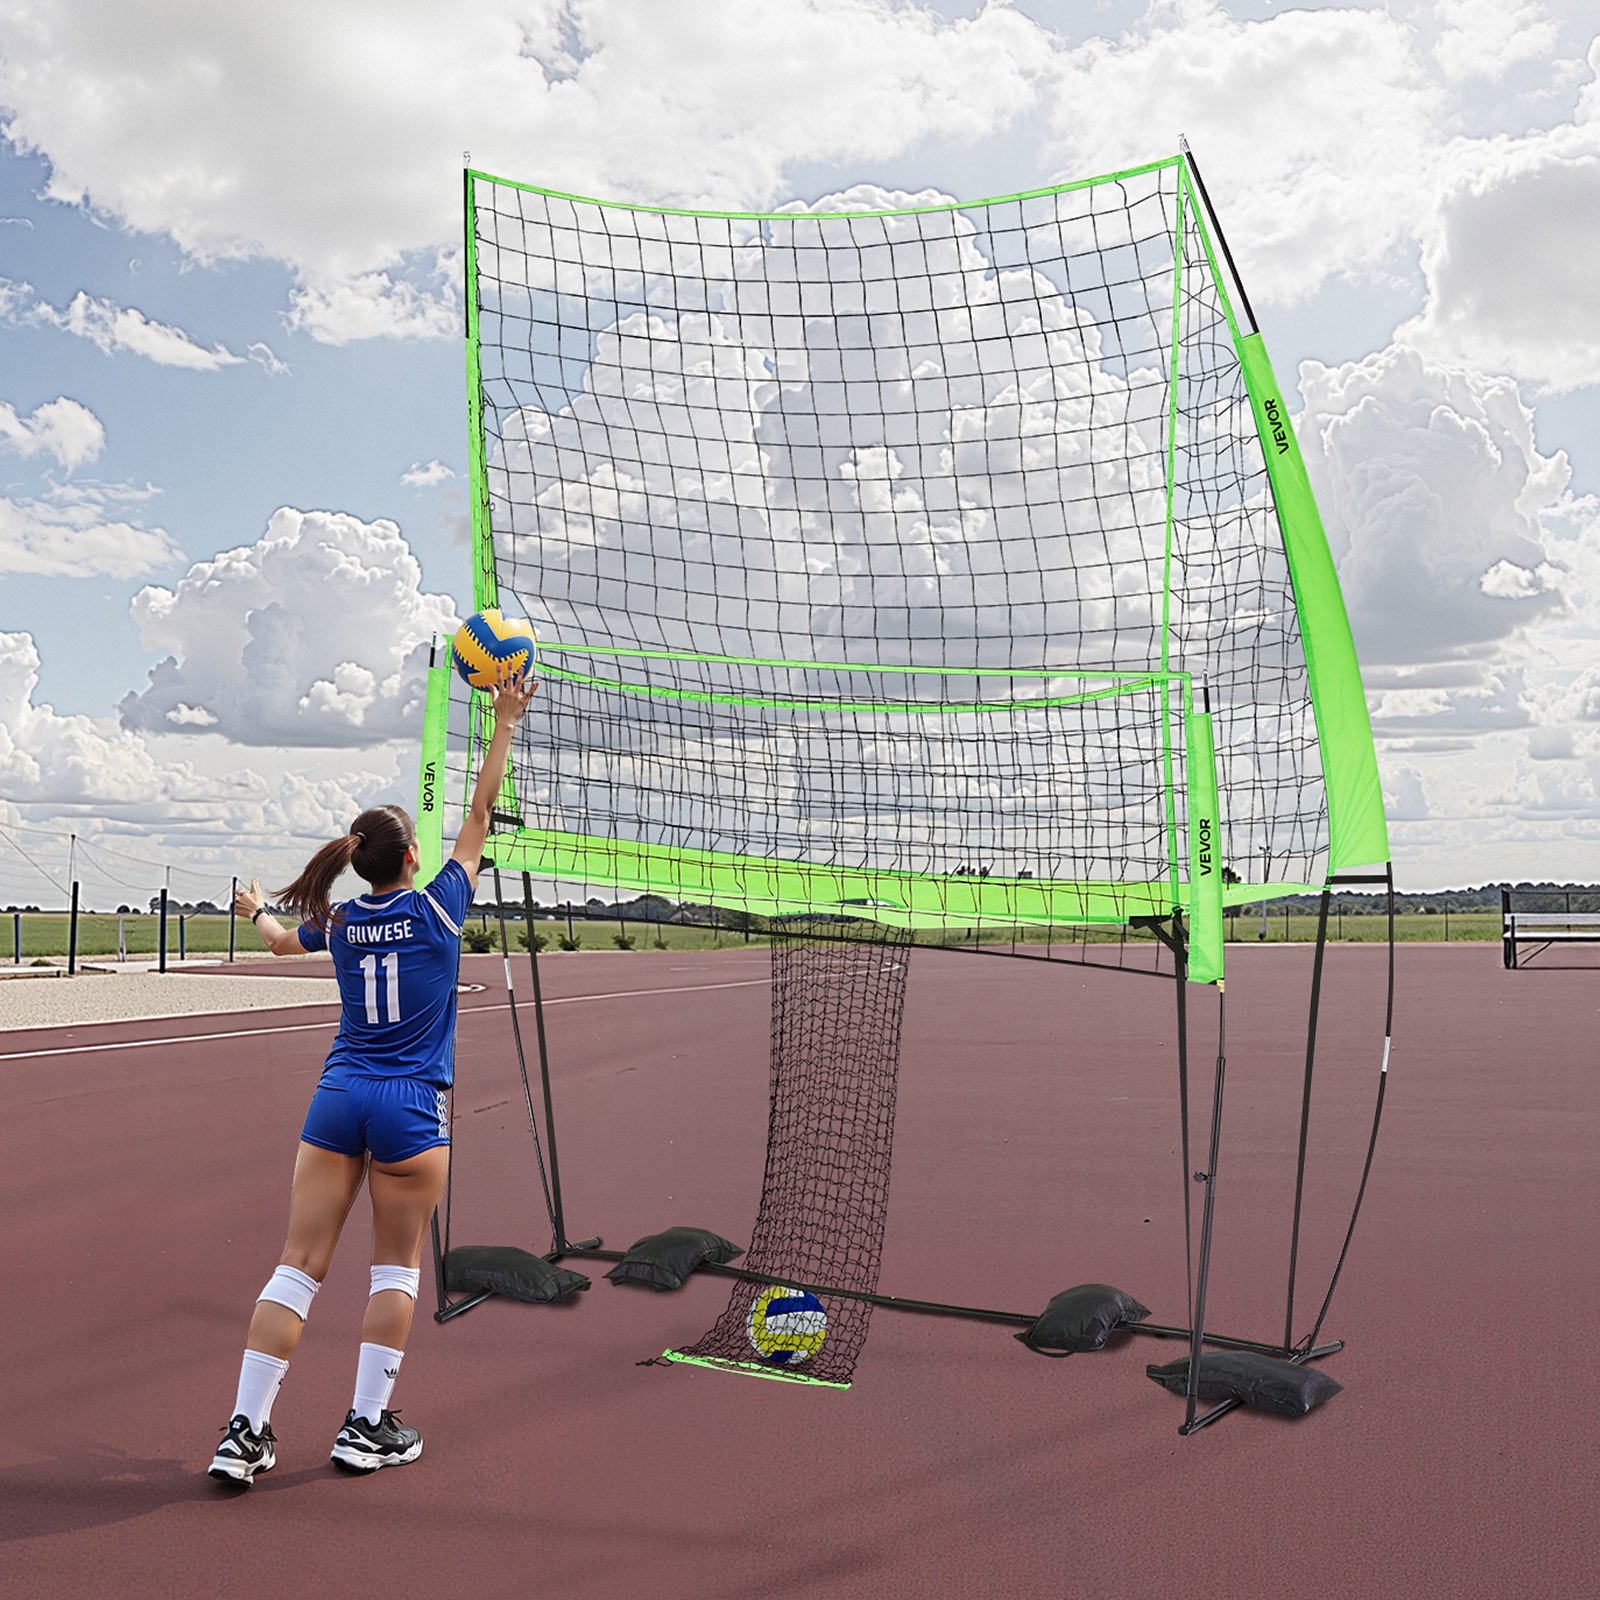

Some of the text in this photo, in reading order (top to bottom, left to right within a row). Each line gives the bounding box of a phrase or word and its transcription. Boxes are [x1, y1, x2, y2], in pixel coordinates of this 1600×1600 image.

[1264, 398, 1289, 455] VEVOR
[423, 762, 436, 812] VEVOR
[1199, 819, 1212, 876] VEVOR
[360, 952, 401, 1024] 11
